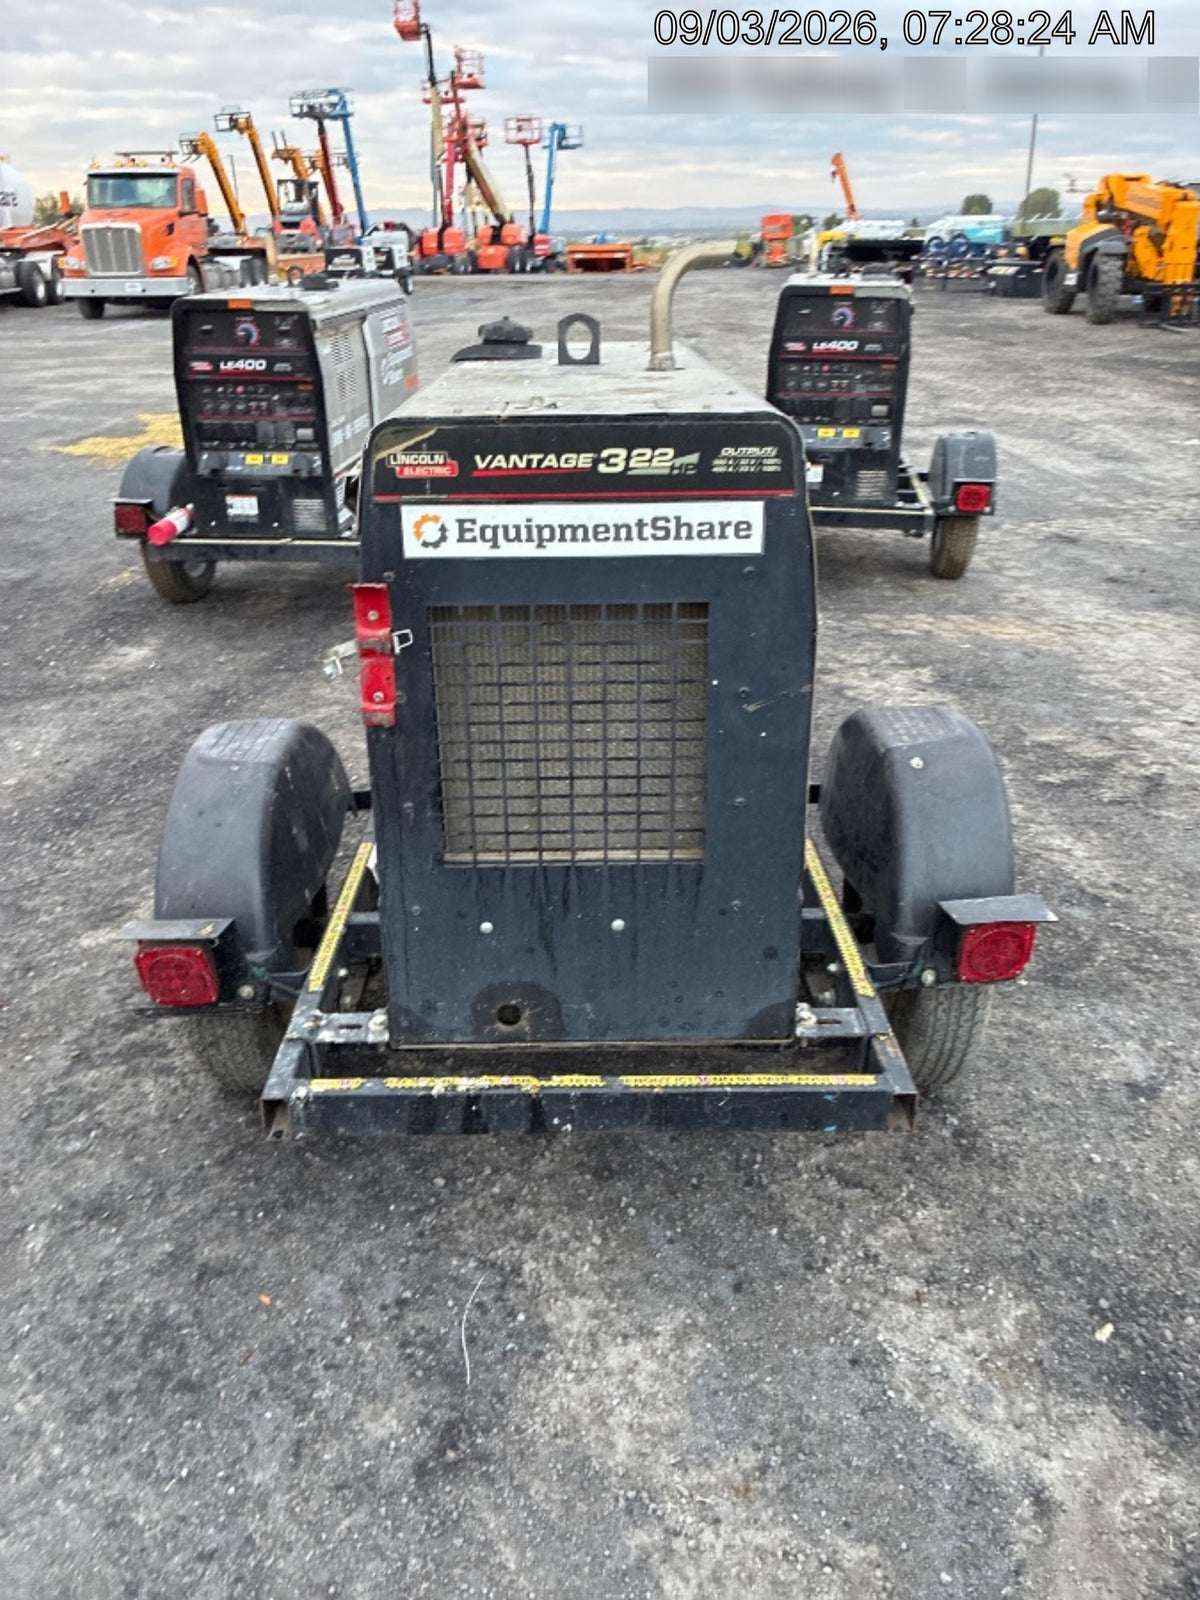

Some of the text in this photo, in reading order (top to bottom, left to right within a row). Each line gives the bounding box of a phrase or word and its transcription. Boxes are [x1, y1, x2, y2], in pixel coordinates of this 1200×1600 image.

[389, 453, 445, 465] LINCOLN
[474, 453, 594, 469] VANTAGE
[597, 447, 675, 473] 322
[402, 465, 454, 476] ELECTRIC
[455, 515, 753, 549] EquipmentShare
